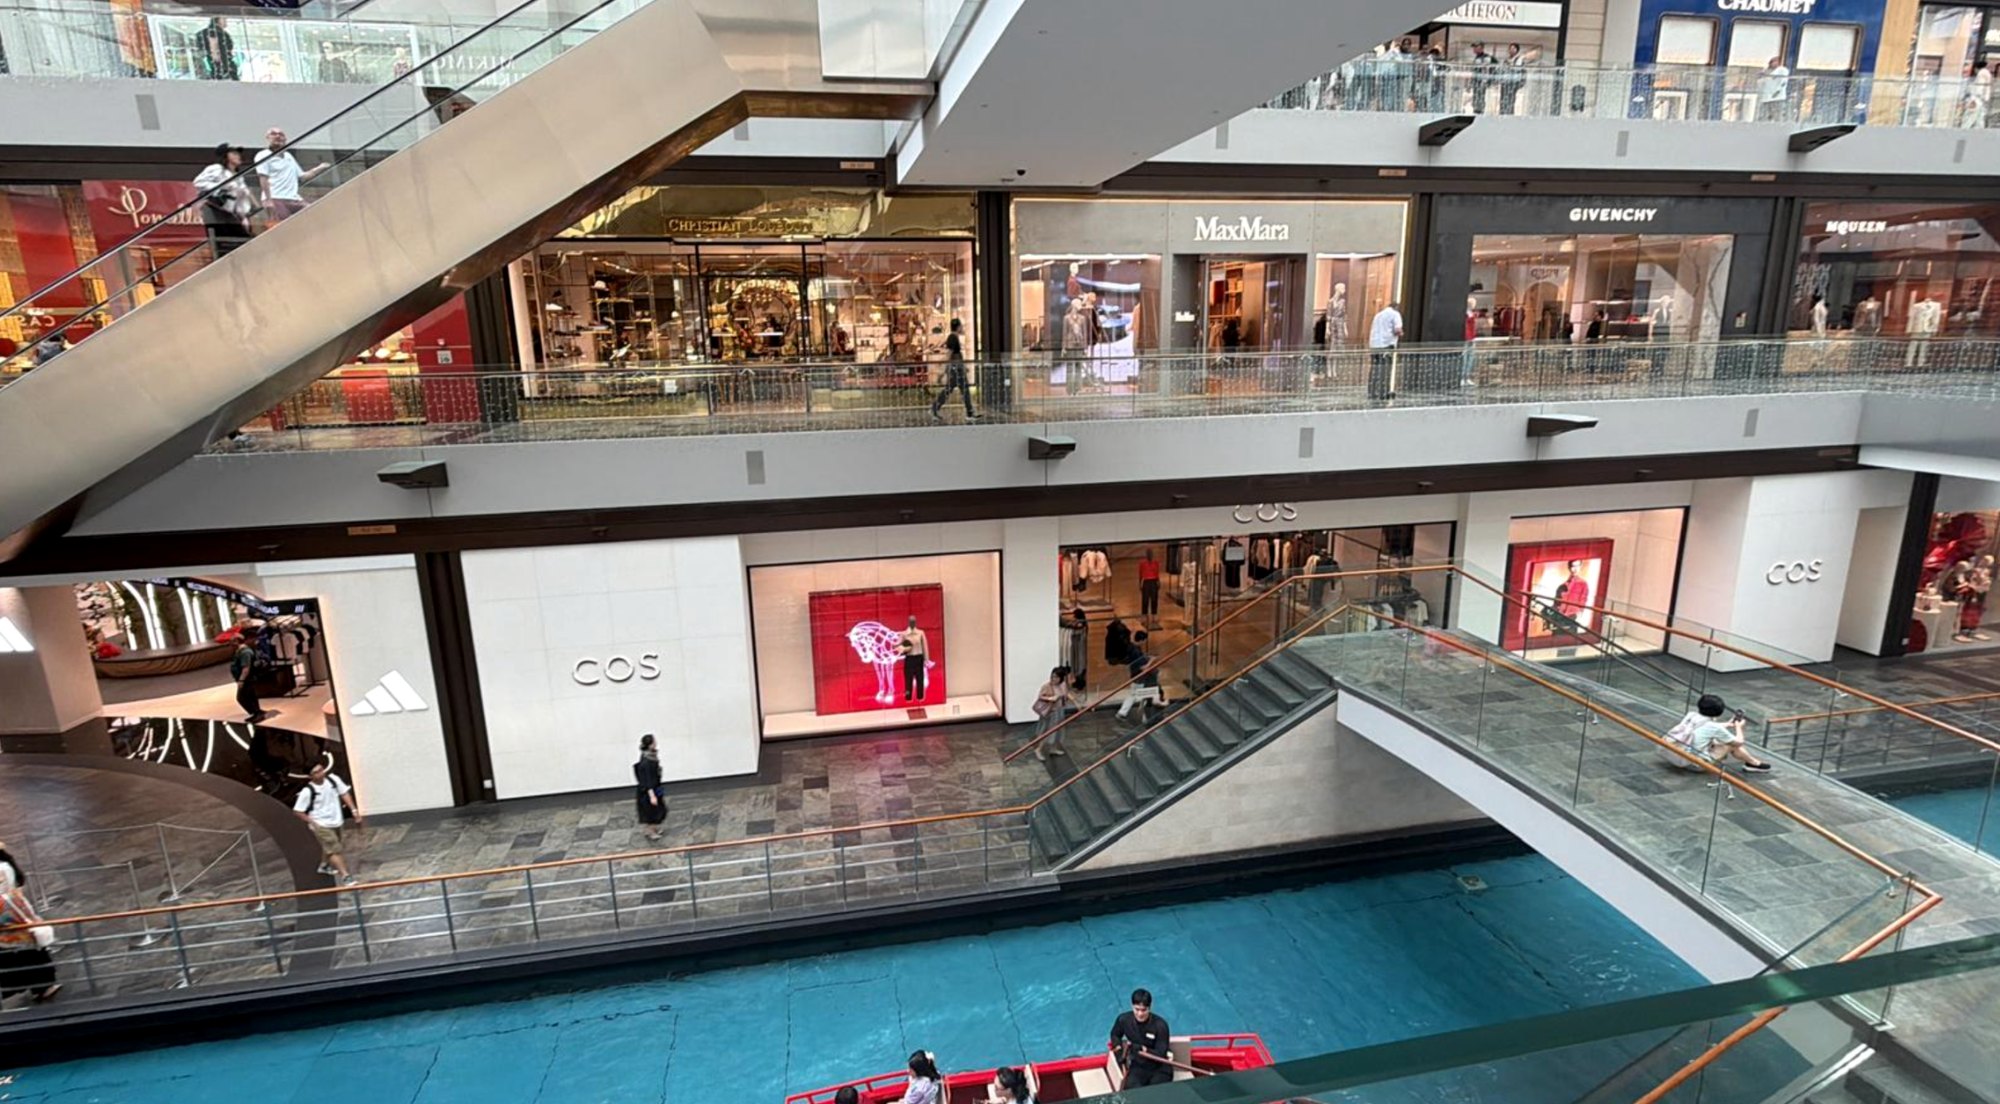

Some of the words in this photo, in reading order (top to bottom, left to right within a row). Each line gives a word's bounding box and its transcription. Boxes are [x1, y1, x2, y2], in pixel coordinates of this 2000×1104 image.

[1448, 2, 1517, 20] CHERON
[1718, 0, 1816, 14] CHAUMET
[1569, 208, 1657, 222] GIVENCHY
[668, 219, 741, 233] CHRISTIAN
[1193, 215, 1290, 241] MaxMara
[1766, 558, 1823, 586] COS
[572, 651, 661, 687] COS
